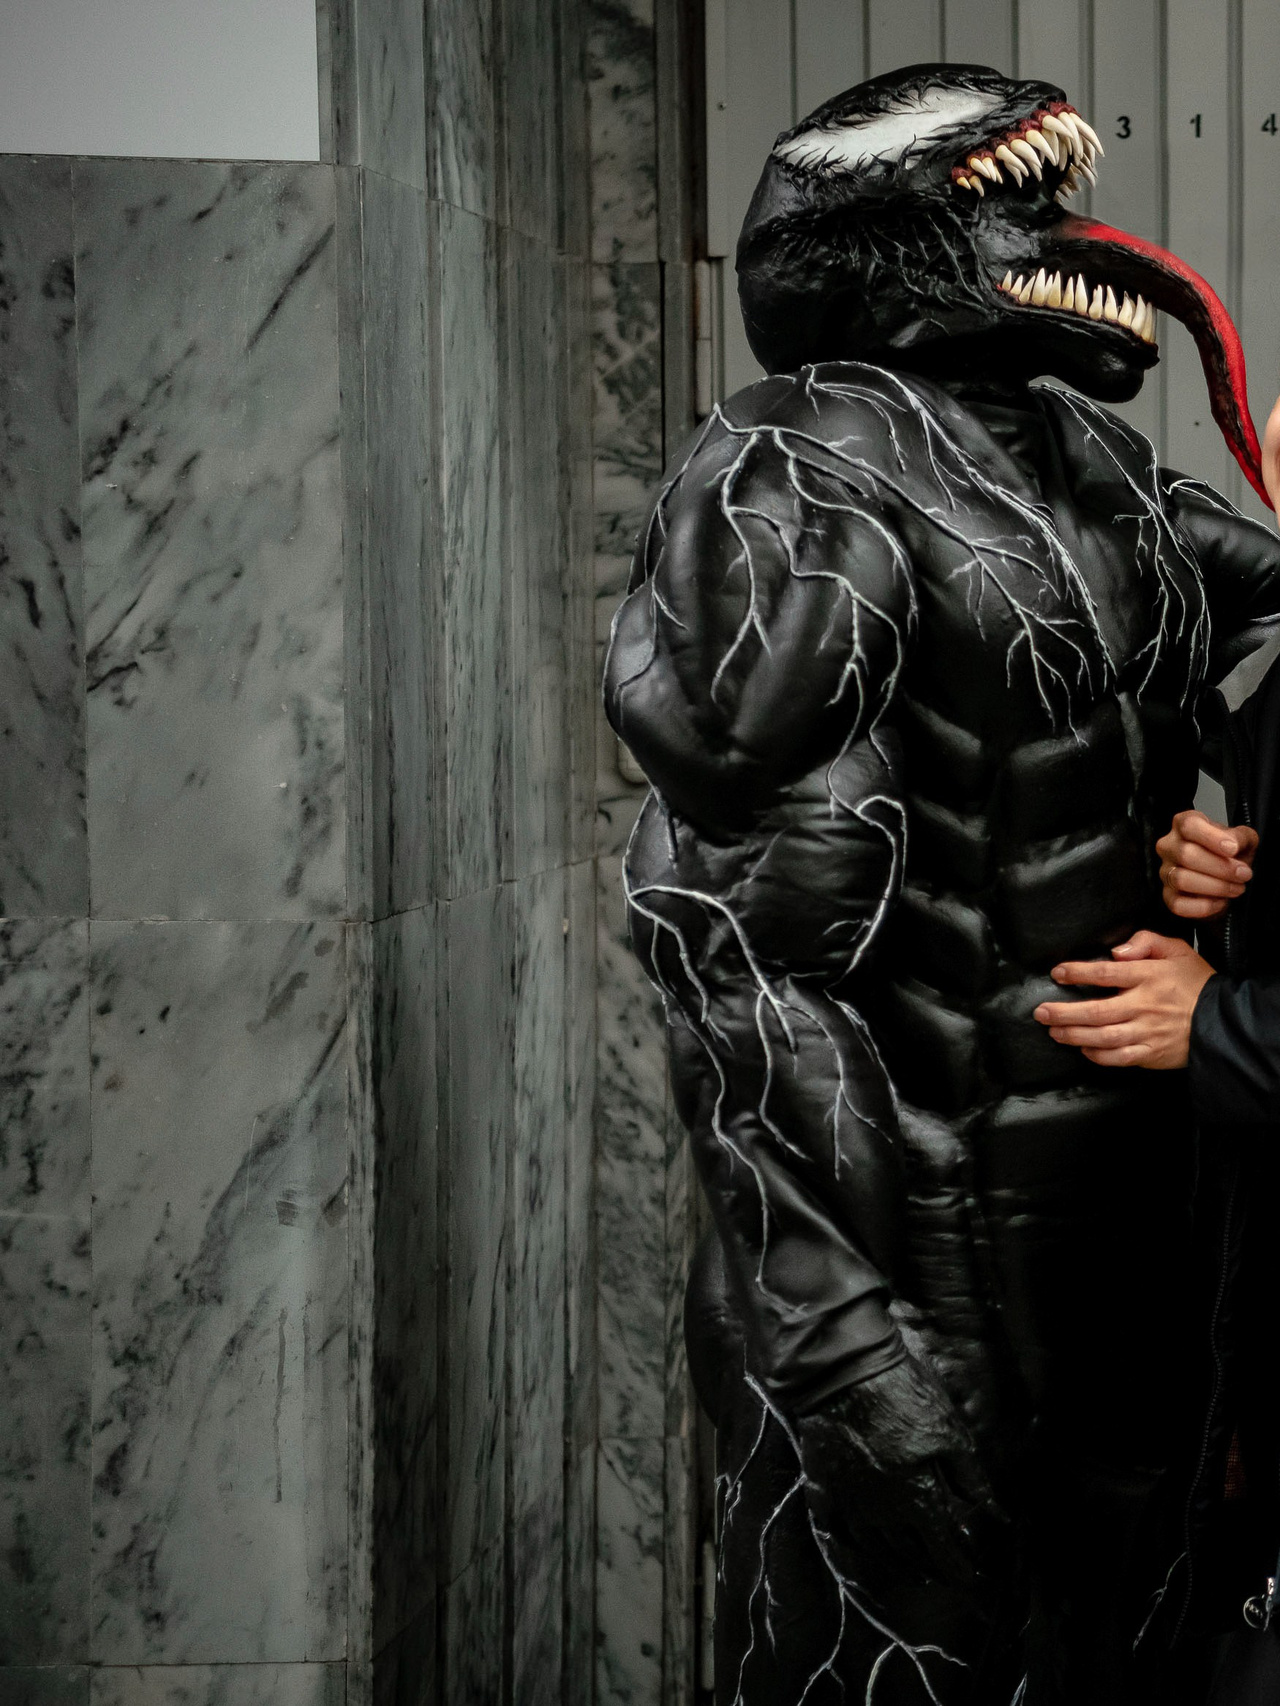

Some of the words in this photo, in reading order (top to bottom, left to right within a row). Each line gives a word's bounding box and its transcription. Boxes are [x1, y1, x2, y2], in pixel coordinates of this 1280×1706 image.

[1114, 114, 1132, 140] 3
[1189, 112, 1202, 139] 1
[1260, 112, 1279, 137] 4
